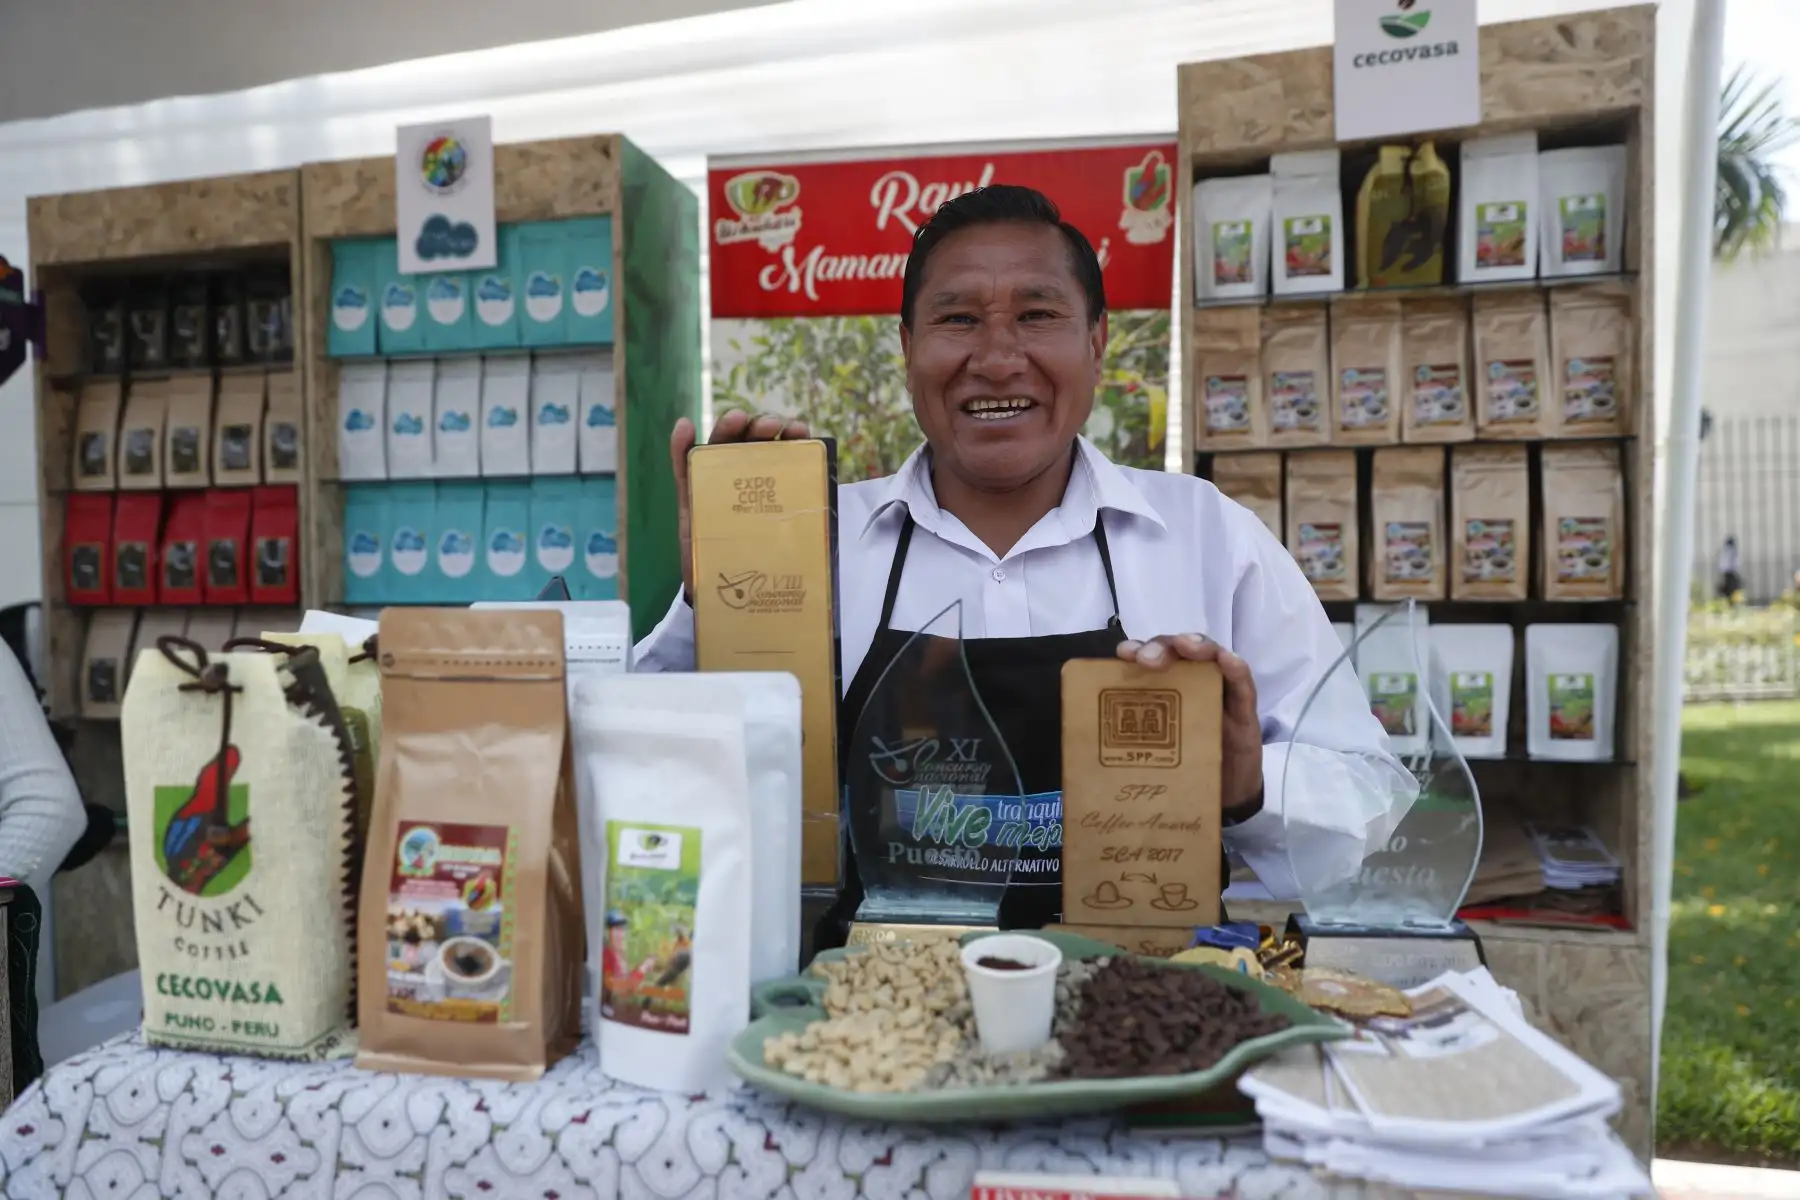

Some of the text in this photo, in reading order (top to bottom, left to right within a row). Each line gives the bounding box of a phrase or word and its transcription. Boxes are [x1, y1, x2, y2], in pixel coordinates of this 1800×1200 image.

[1353, 40, 1459, 68] cecovasa
[944, 738, 983, 762] XI
[1115, 784, 1168, 802] SPP
[912, 784, 993, 848] Vive
[995, 818, 1063, 852] mejo
[888, 841, 981, 865] Puesto
[1100, 846, 1184, 863] SCA 2017
[1343, 862, 1438, 889] uesto
[157, 886, 266, 934] TUNKI
[156, 972, 284, 1005] CECOVASA
[165, 1012, 280, 1039] PUNO PERU
